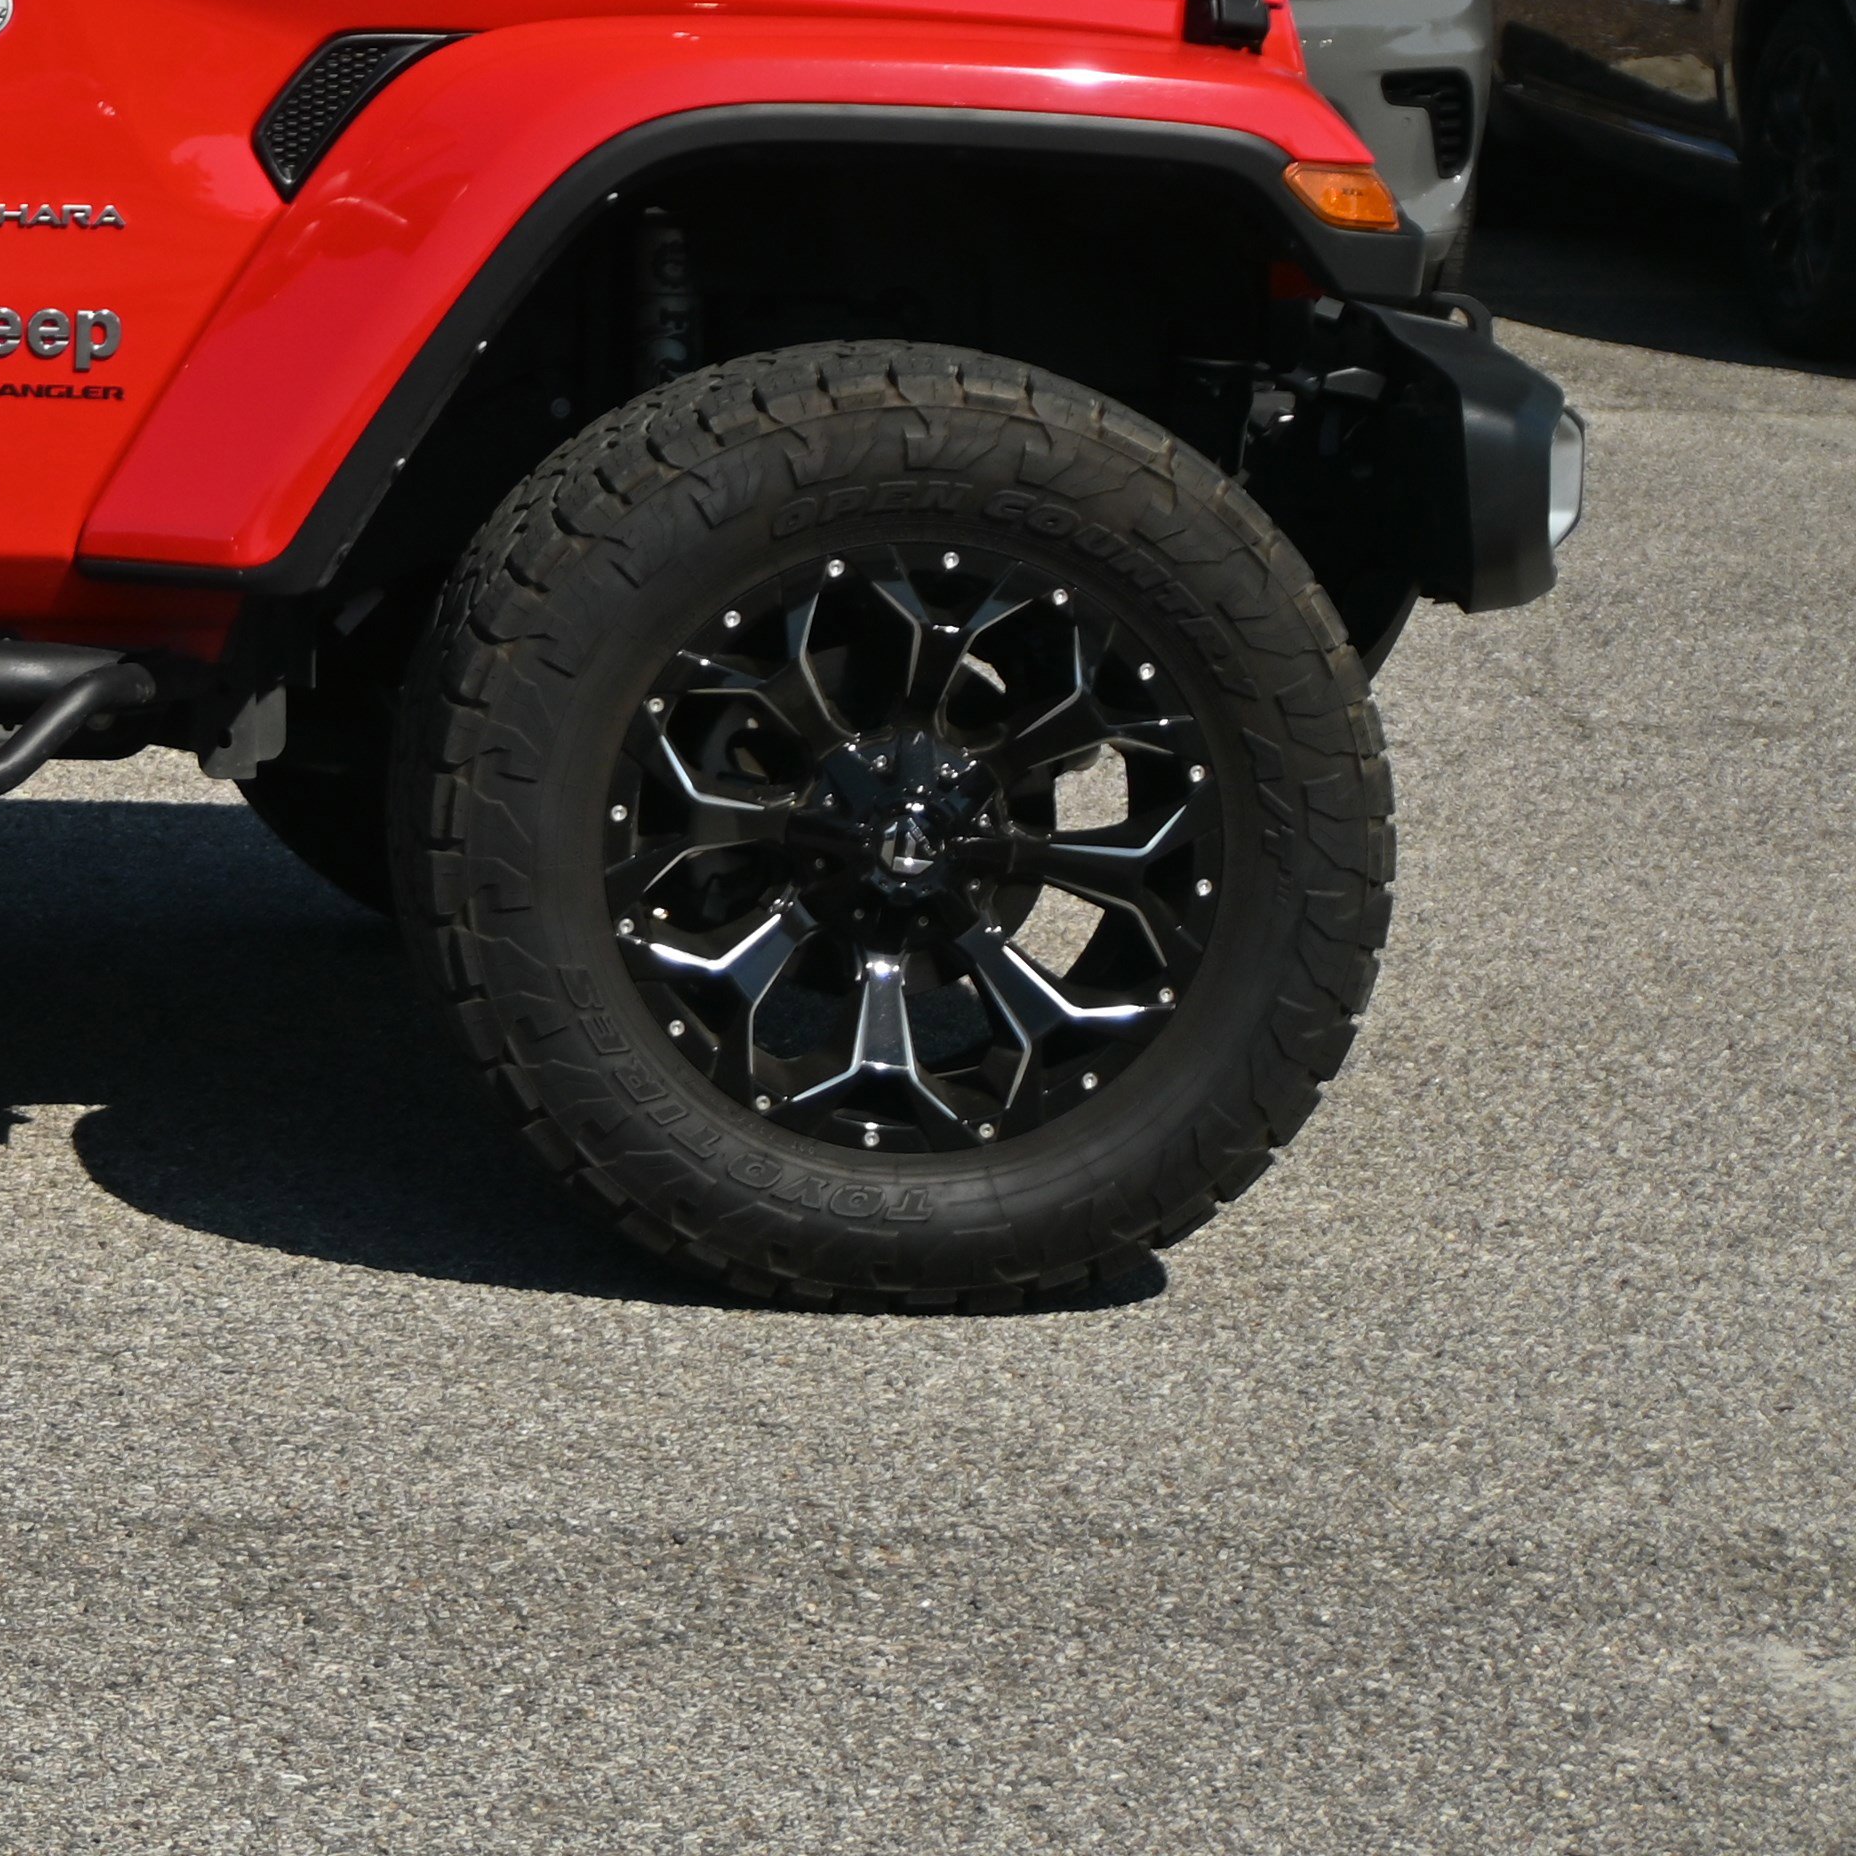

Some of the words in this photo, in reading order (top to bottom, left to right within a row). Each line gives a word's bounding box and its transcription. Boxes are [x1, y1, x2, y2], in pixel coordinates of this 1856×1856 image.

[771, 480, 975, 540] OPEN
[982, 488, 1261, 700] COUNTRY
[558, 963, 722, 1160] TIRES
[727, 1152, 935, 1222] TOYO
